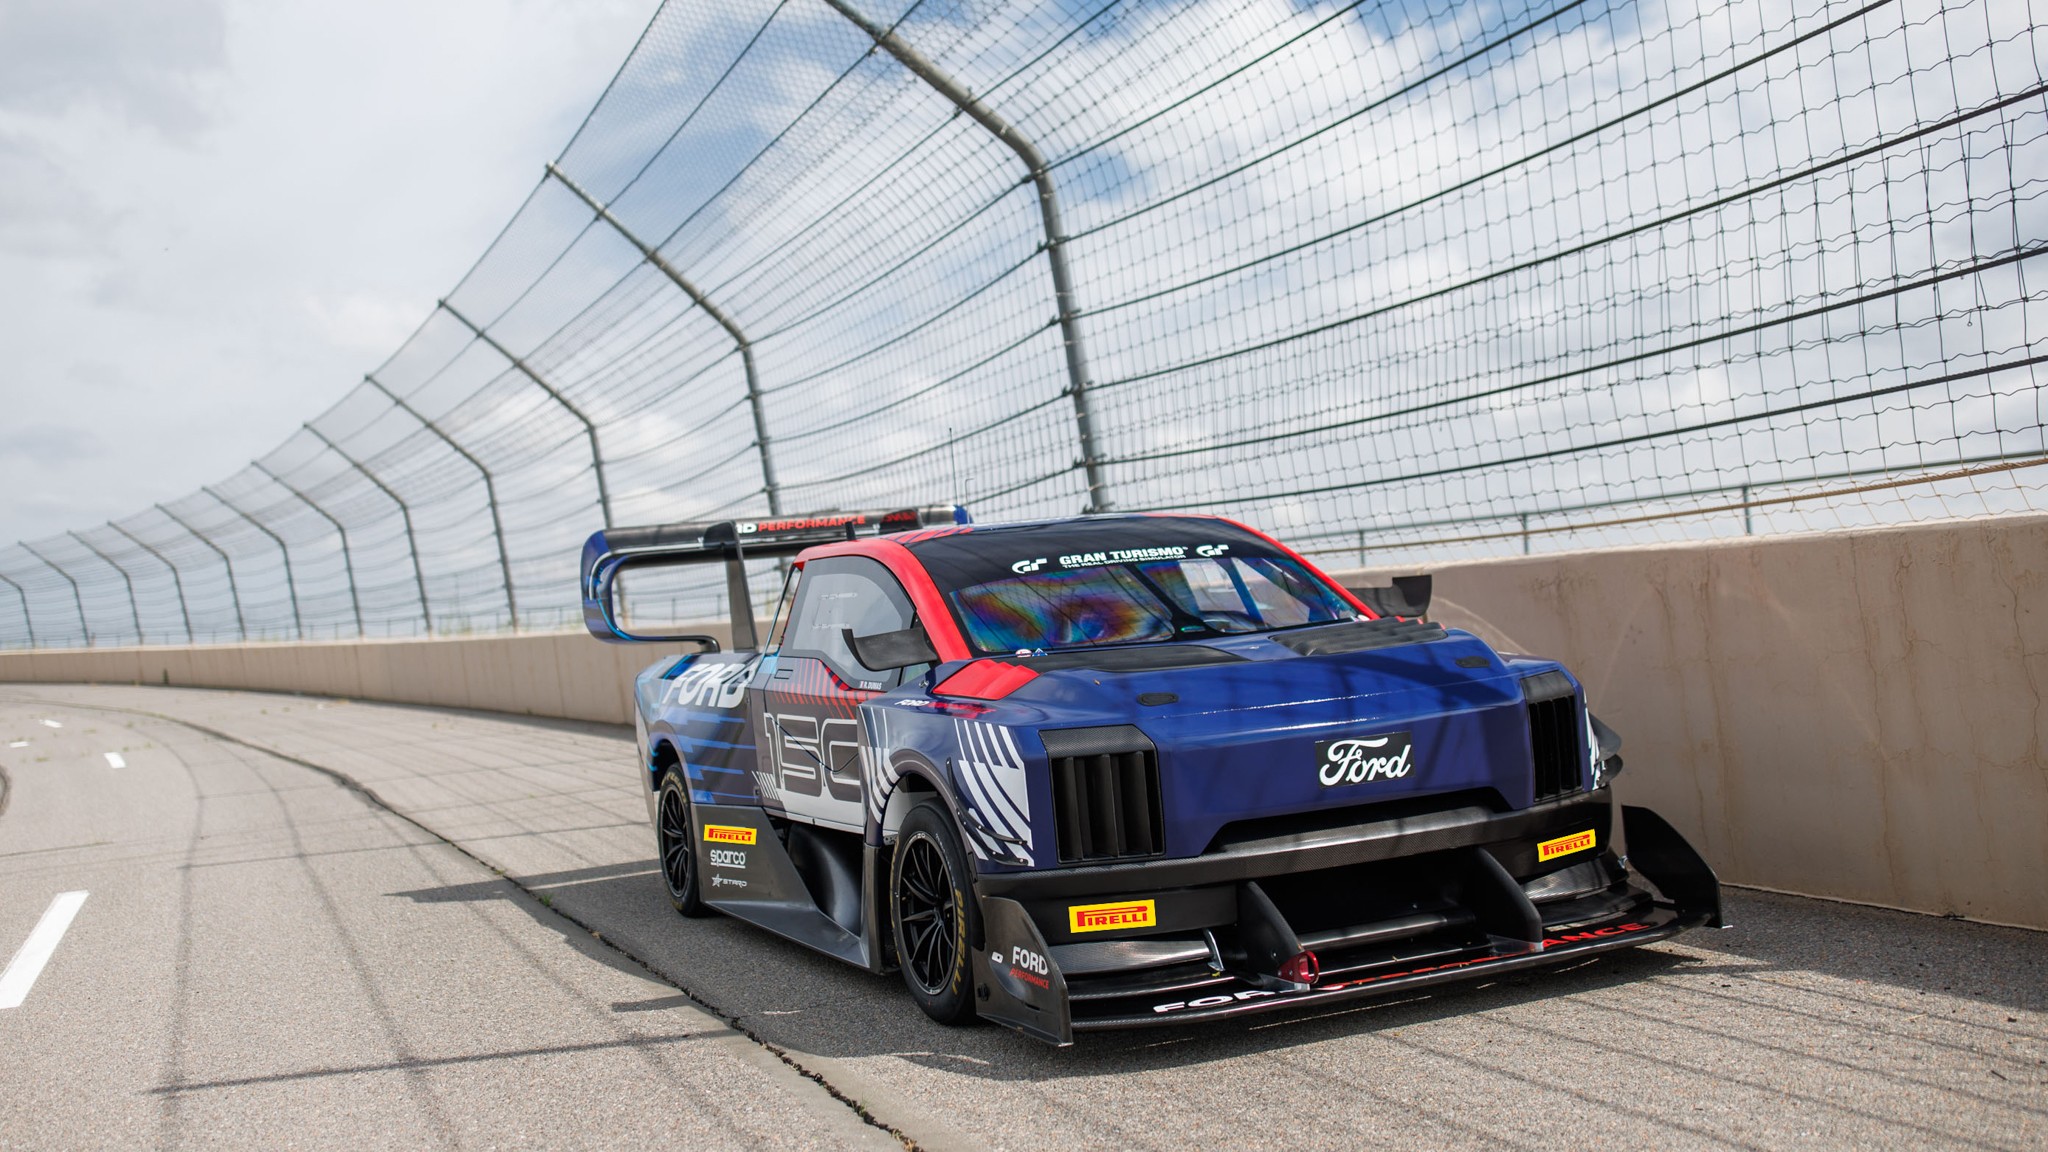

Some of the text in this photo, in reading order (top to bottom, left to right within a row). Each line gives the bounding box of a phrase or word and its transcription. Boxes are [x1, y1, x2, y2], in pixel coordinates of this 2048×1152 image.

[1059, 551, 1107, 565] GRAN
[662, 662, 757, 708] FORD
[1319, 737, 1412, 786] Ford
[708, 828, 752, 841] PIRELLI
[1542, 833, 1590, 856] PIRELLI
[710, 849, 746, 867] sparco
[1076, 906, 1148, 927] PIRELLI
[1012, 946, 1049, 976] FORD
[1009, 968, 1049, 990] PERFORMANCE
